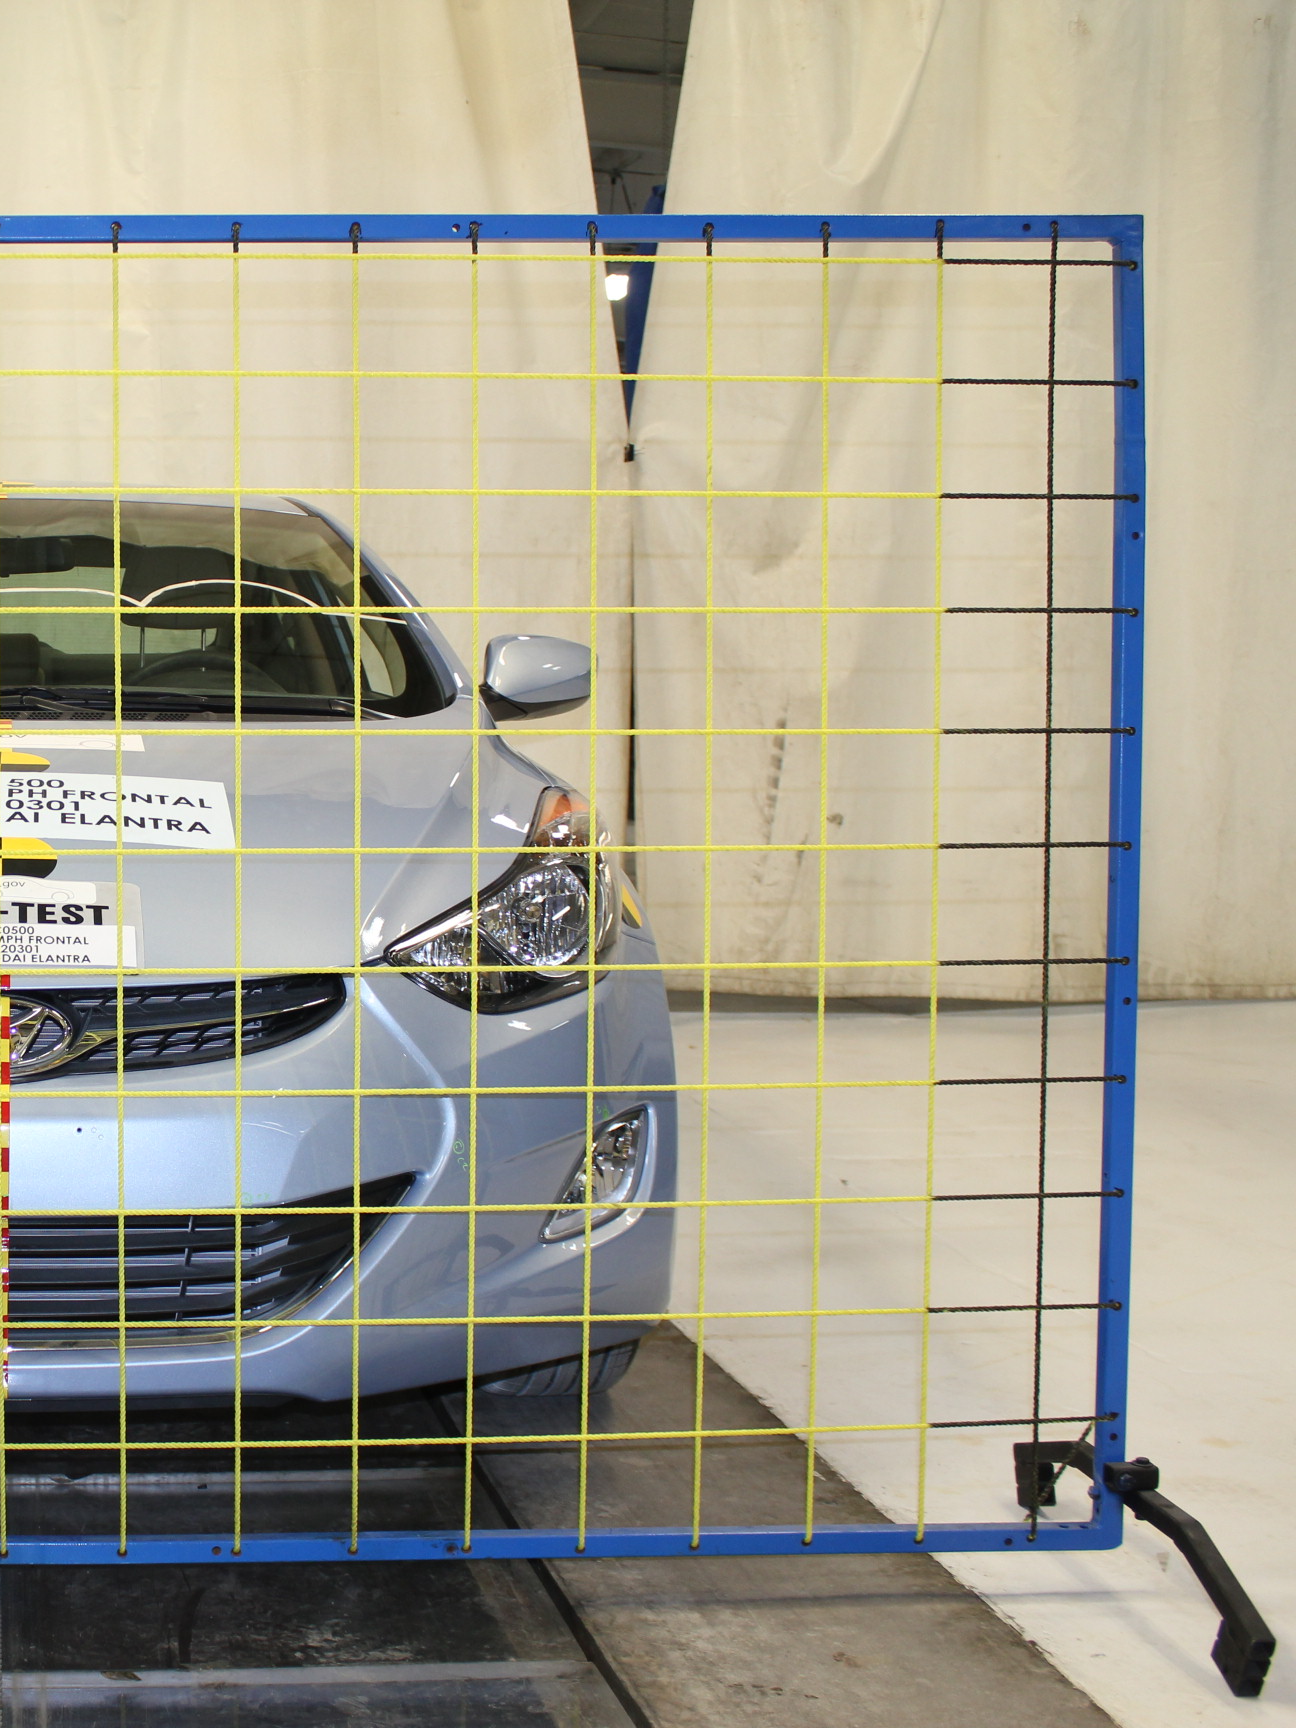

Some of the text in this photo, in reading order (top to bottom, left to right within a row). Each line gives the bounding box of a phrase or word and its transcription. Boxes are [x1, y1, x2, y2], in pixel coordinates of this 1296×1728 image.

[62, 789, 213, 809] FRONTAL
[60, 812, 212, 834] ELANTRA
[28, 935, 89, 945] FRONTAL
[31, 954, 91, 963] ELANTRA
